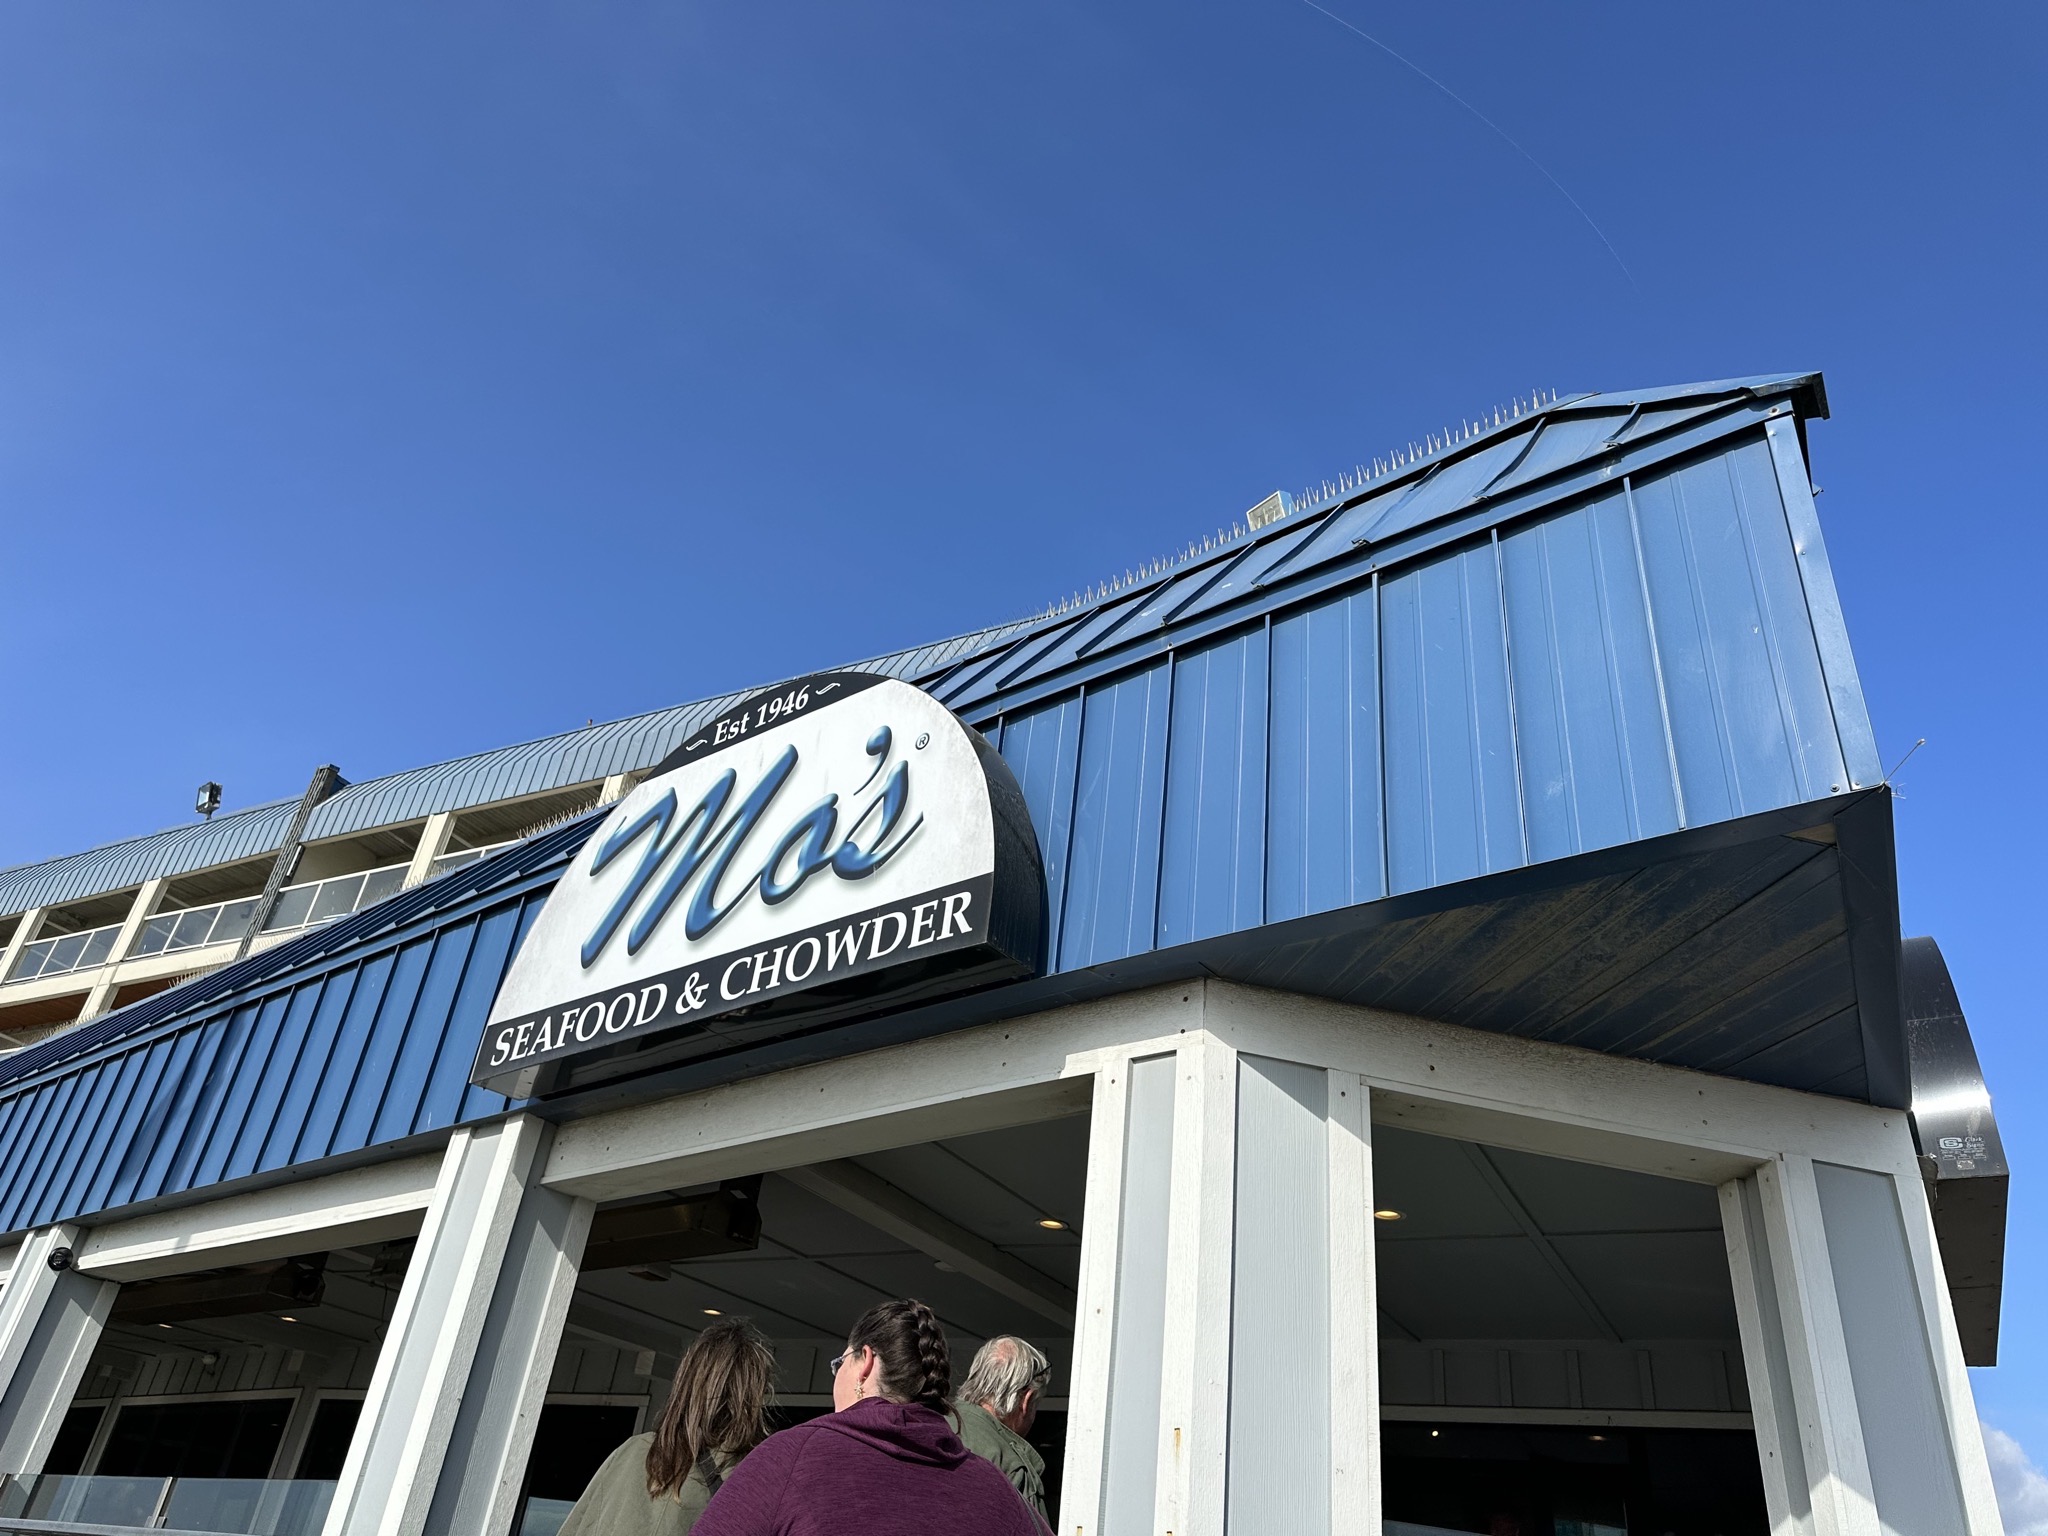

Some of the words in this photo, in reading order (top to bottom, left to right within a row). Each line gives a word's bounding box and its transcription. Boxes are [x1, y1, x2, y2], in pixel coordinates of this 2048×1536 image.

[712, 711, 750, 746] Est
[754, 685, 810, 729] 1946
[580, 724, 924, 970] Mo's
[489, 982, 667, 1067] SEAFOOD
[675, 972, 708, 1014] &
[719, 890, 974, 1001] CHOWDER
